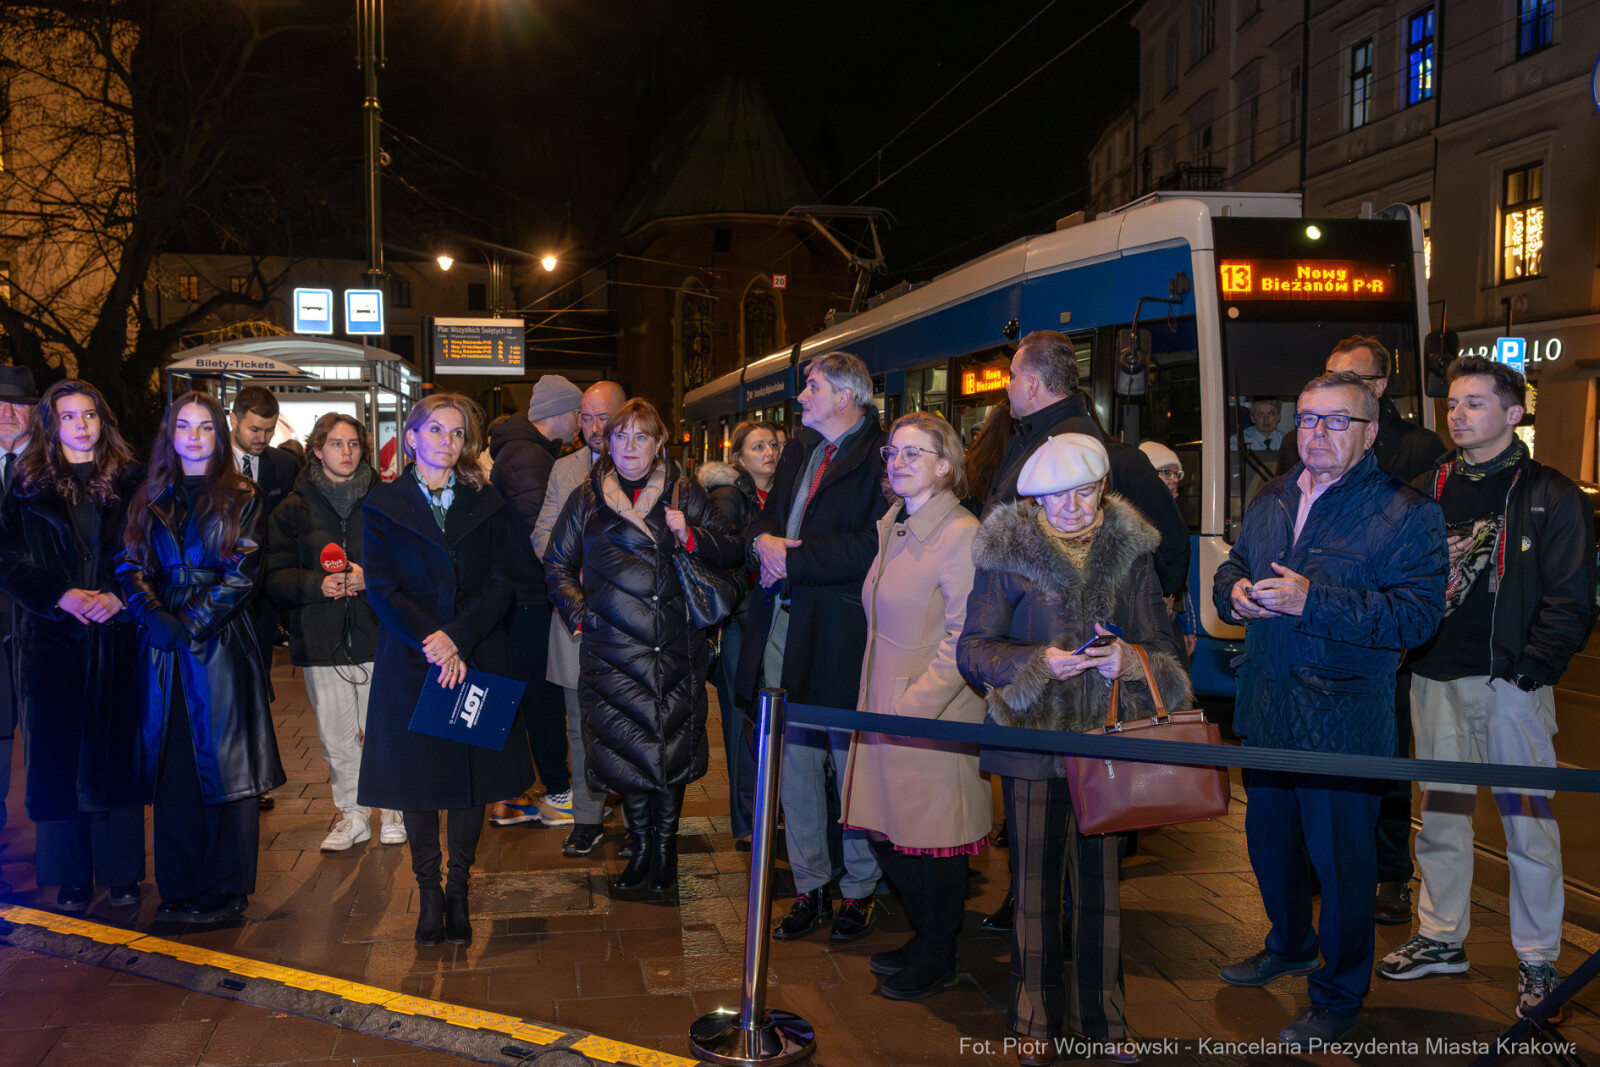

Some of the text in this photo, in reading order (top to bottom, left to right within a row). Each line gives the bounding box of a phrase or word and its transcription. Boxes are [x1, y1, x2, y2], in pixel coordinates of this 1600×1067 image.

[1222, 266, 1346, 291] 13 Nowy
[1261, 277, 1384, 292] Bieżanów P+R
[481, 327, 505, 335] Świętych
[1502, 341, 1519, 363] P
[196, 359, 275, 369] Bilety-Tickets
[460, 684, 485, 729] LOT
